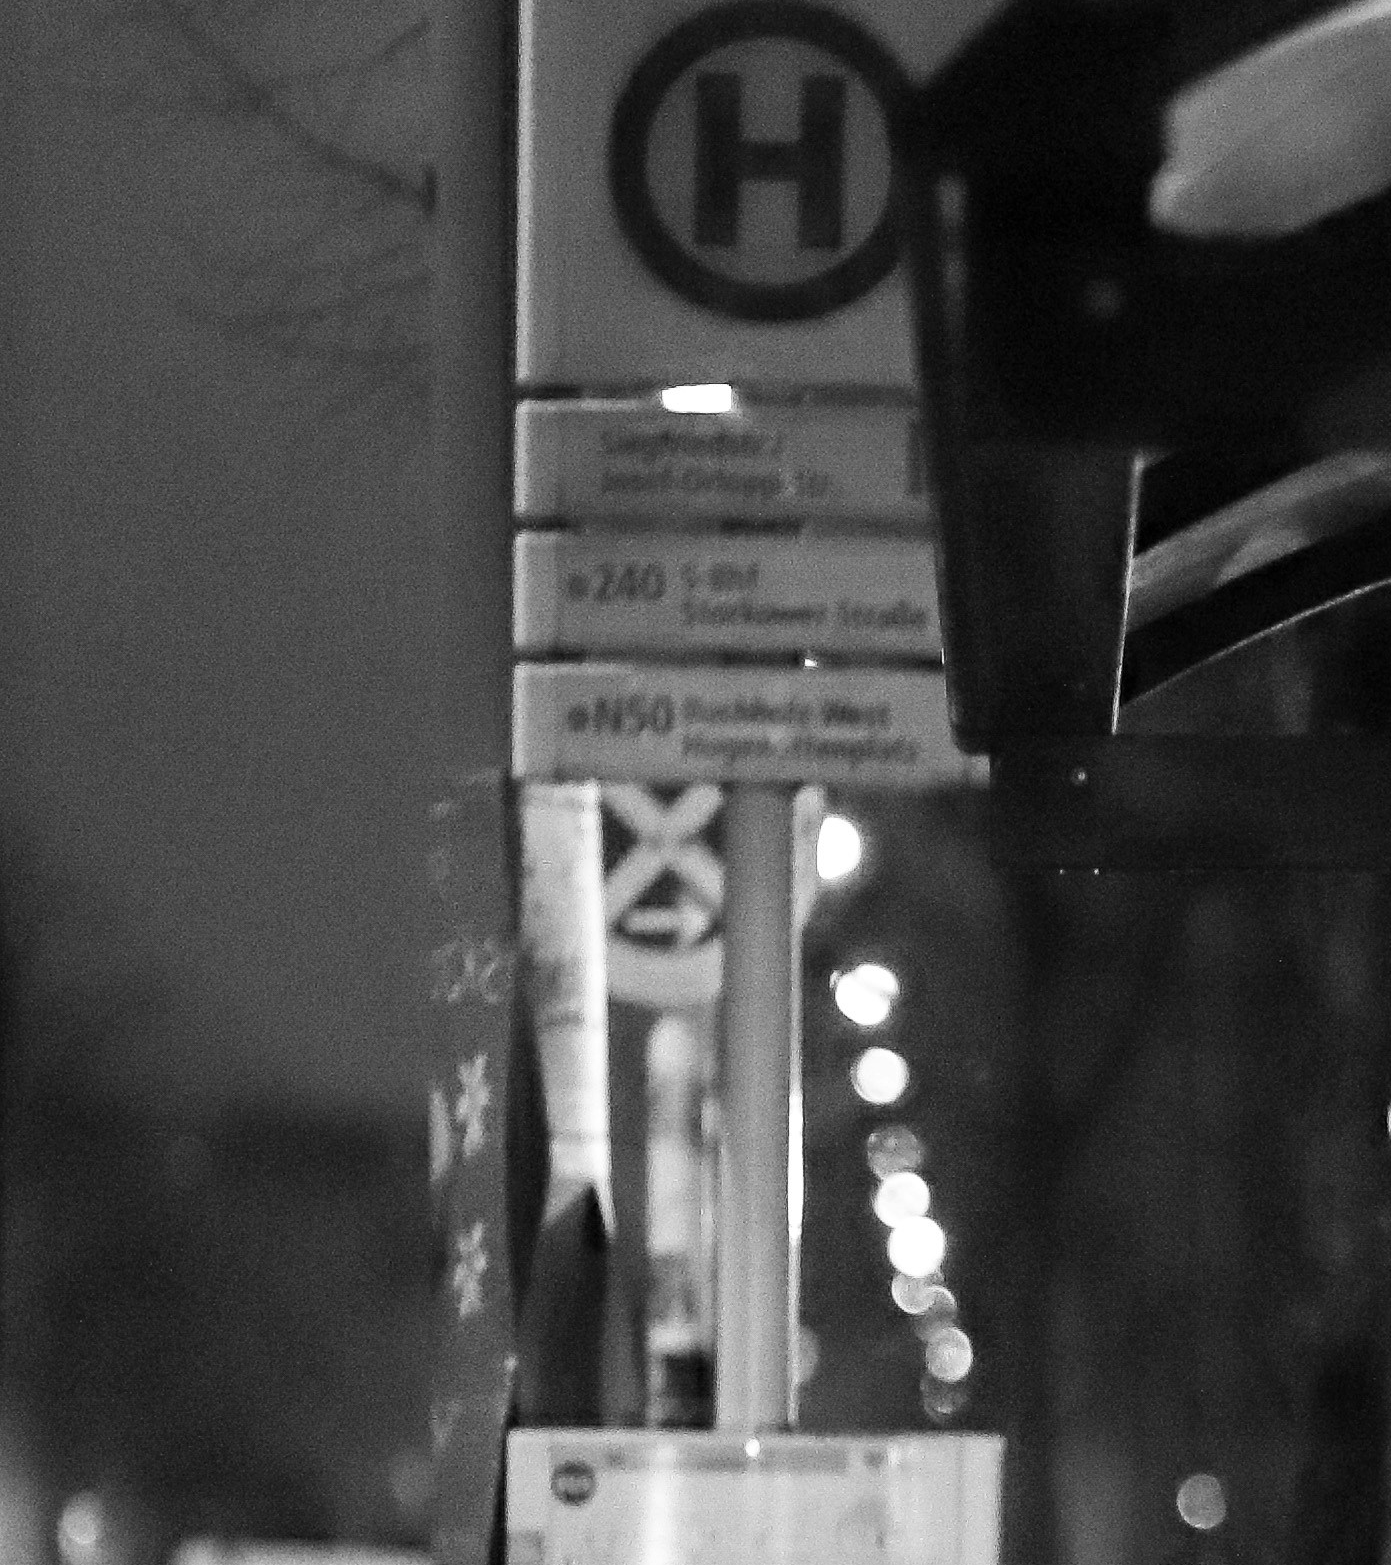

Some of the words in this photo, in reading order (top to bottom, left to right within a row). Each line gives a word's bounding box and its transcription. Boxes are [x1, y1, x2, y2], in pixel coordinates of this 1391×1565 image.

[694, 71, 848, 251] H
[595, 562, 669, 602] 240
[593, 694, 675, 734] N50
